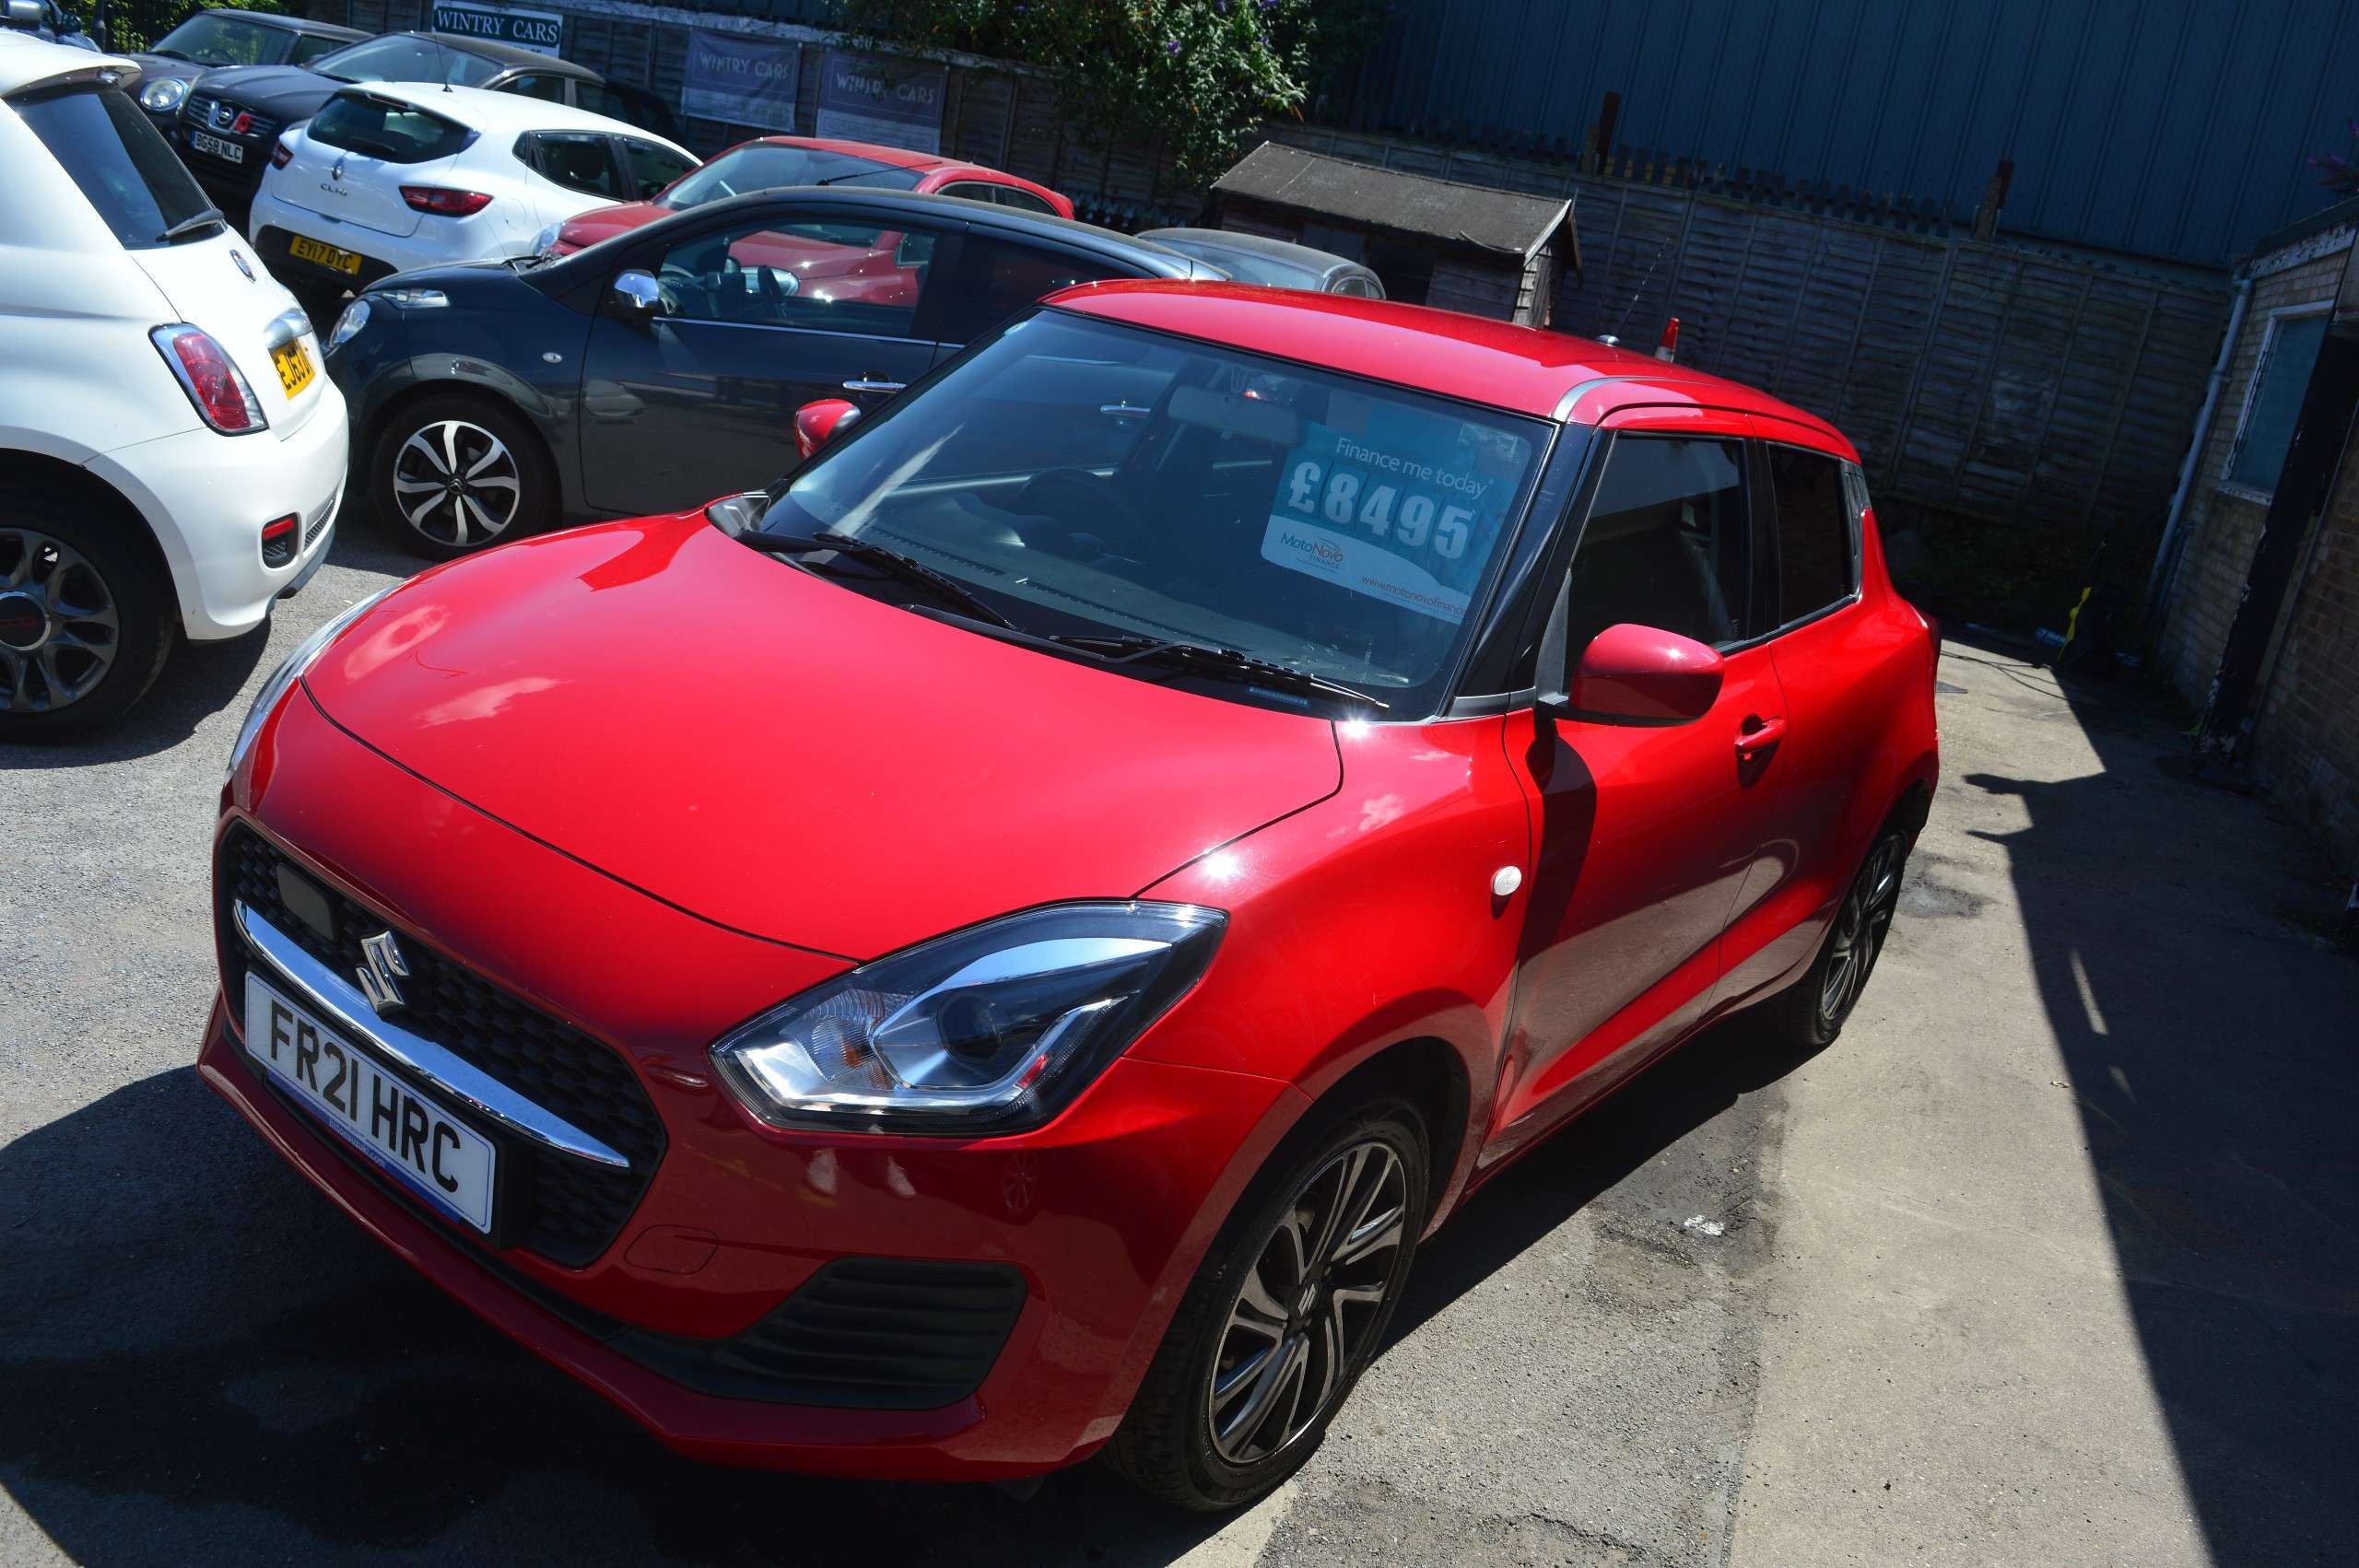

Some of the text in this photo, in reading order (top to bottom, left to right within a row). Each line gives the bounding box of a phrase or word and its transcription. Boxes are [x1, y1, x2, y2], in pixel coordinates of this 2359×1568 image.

[437, 9, 558, 43] WINTRY CARS
[699, 53, 790, 80] WINTRY CARS
[898, 85, 935, 104] CARS
[220, 138, 241, 160] NLC
[320, 183, 348, 196] CLIO
[296, 239, 325, 260] EY17
[1336, 436, 1401, 472] Finance
[1403, 460, 1433, 479] me
[1288, 462, 1475, 559] £8495
[1281, 532, 1344, 562] MotoNovo
[1309, 555, 1341, 569] FINANCE
[270, 999, 461, 1193] FR21 HRC
